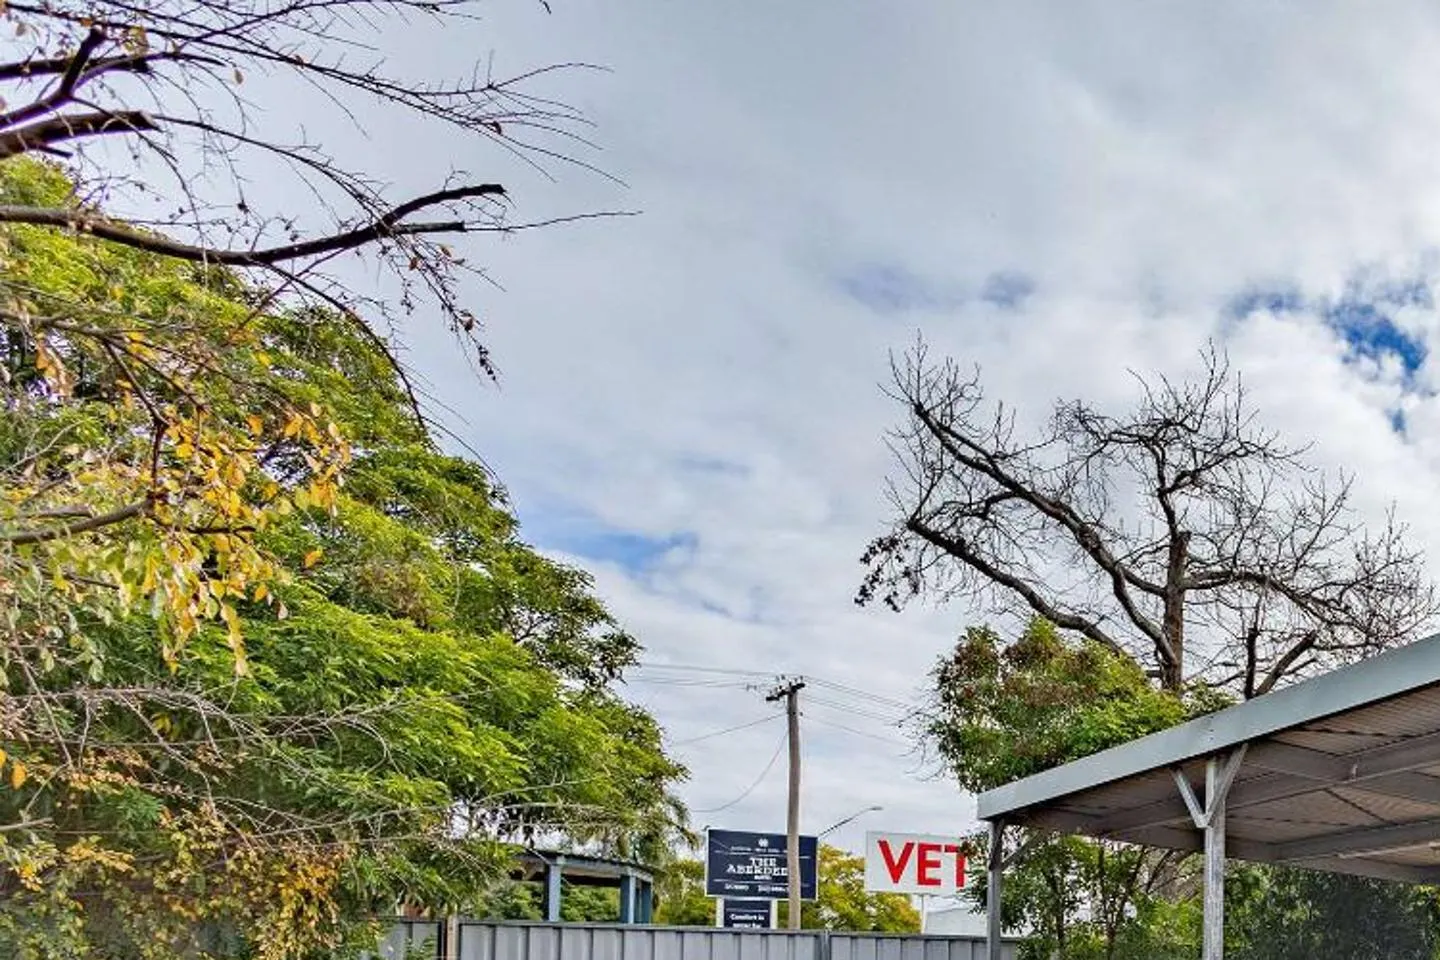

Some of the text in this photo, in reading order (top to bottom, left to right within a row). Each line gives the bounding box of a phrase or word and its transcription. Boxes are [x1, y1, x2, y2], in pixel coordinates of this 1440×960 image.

[749, 857, 776, 867] THE
[877, 839, 967, 888] VET
[726, 864, 788, 876] ABERDEE
